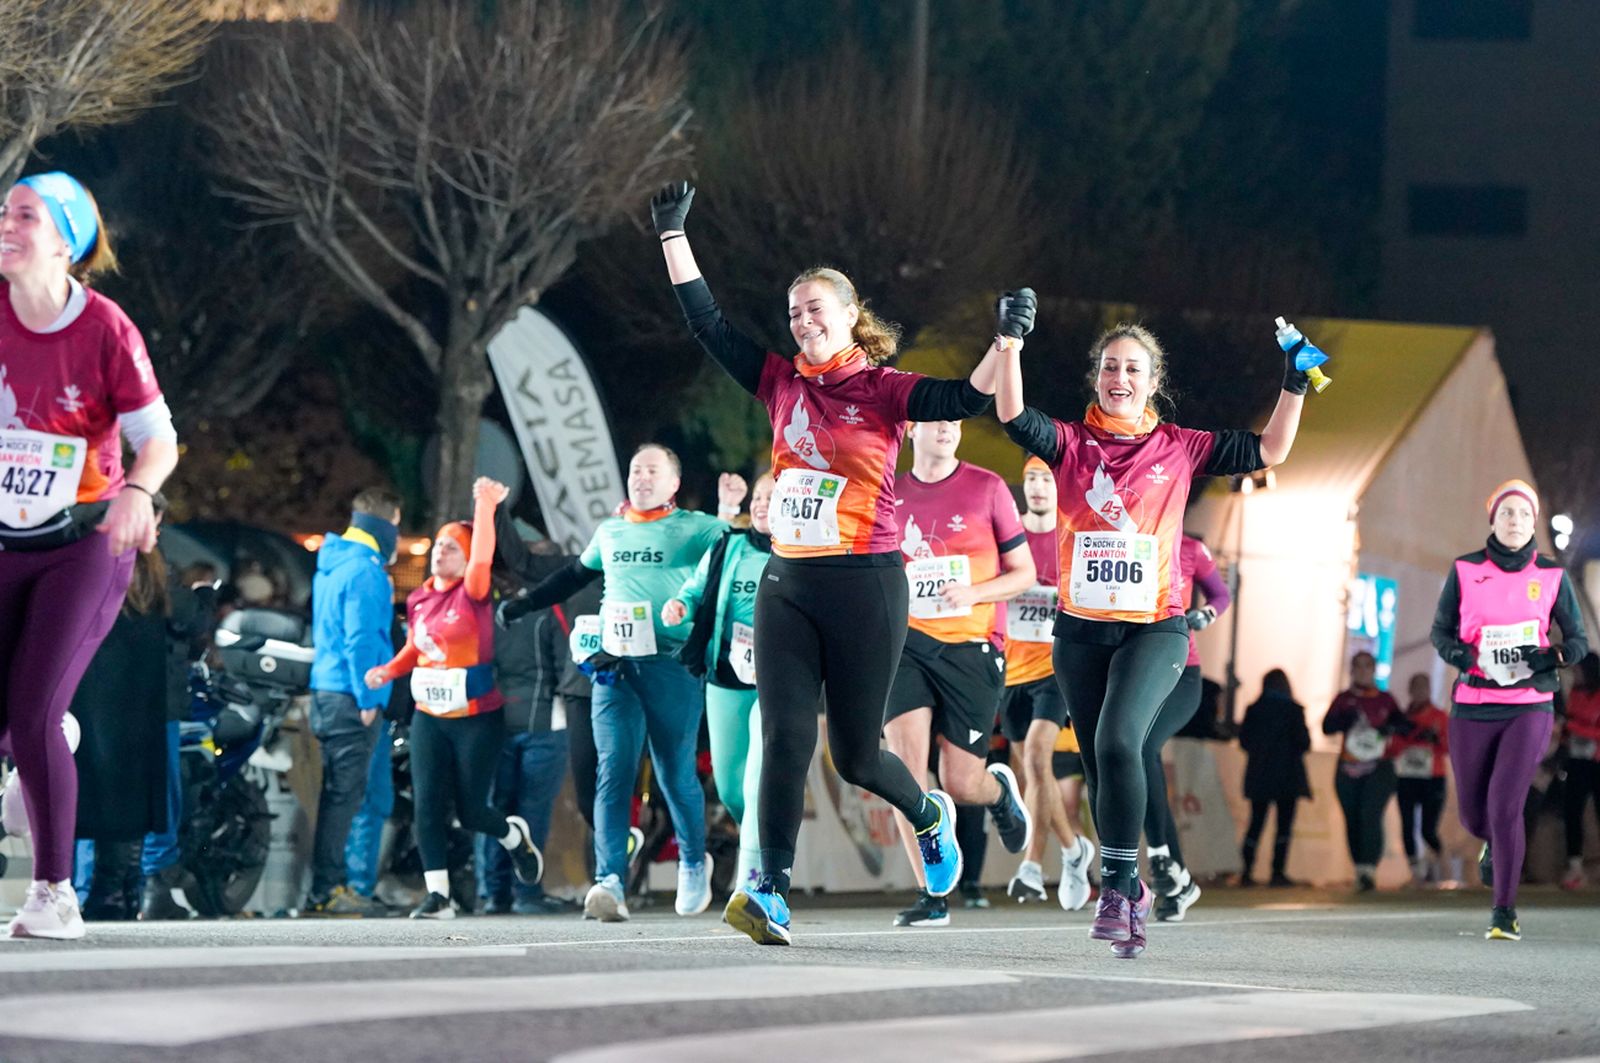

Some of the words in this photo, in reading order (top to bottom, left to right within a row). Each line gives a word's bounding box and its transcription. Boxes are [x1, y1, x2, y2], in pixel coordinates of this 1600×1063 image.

[546, 358, 611, 521] PEMASA
[794, 437, 814, 457] 43
[1, 466, 57, 497] 4327
[1101, 500, 1122, 521] 43
[612, 546, 664, 563] serás
[1083, 550, 1098, 558] SAN
[1099, 549, 1127, 558] ANTÓN
[1092, 541, 1116, 549] NOCHE
[1086, 560, 1143, 584] 5806
